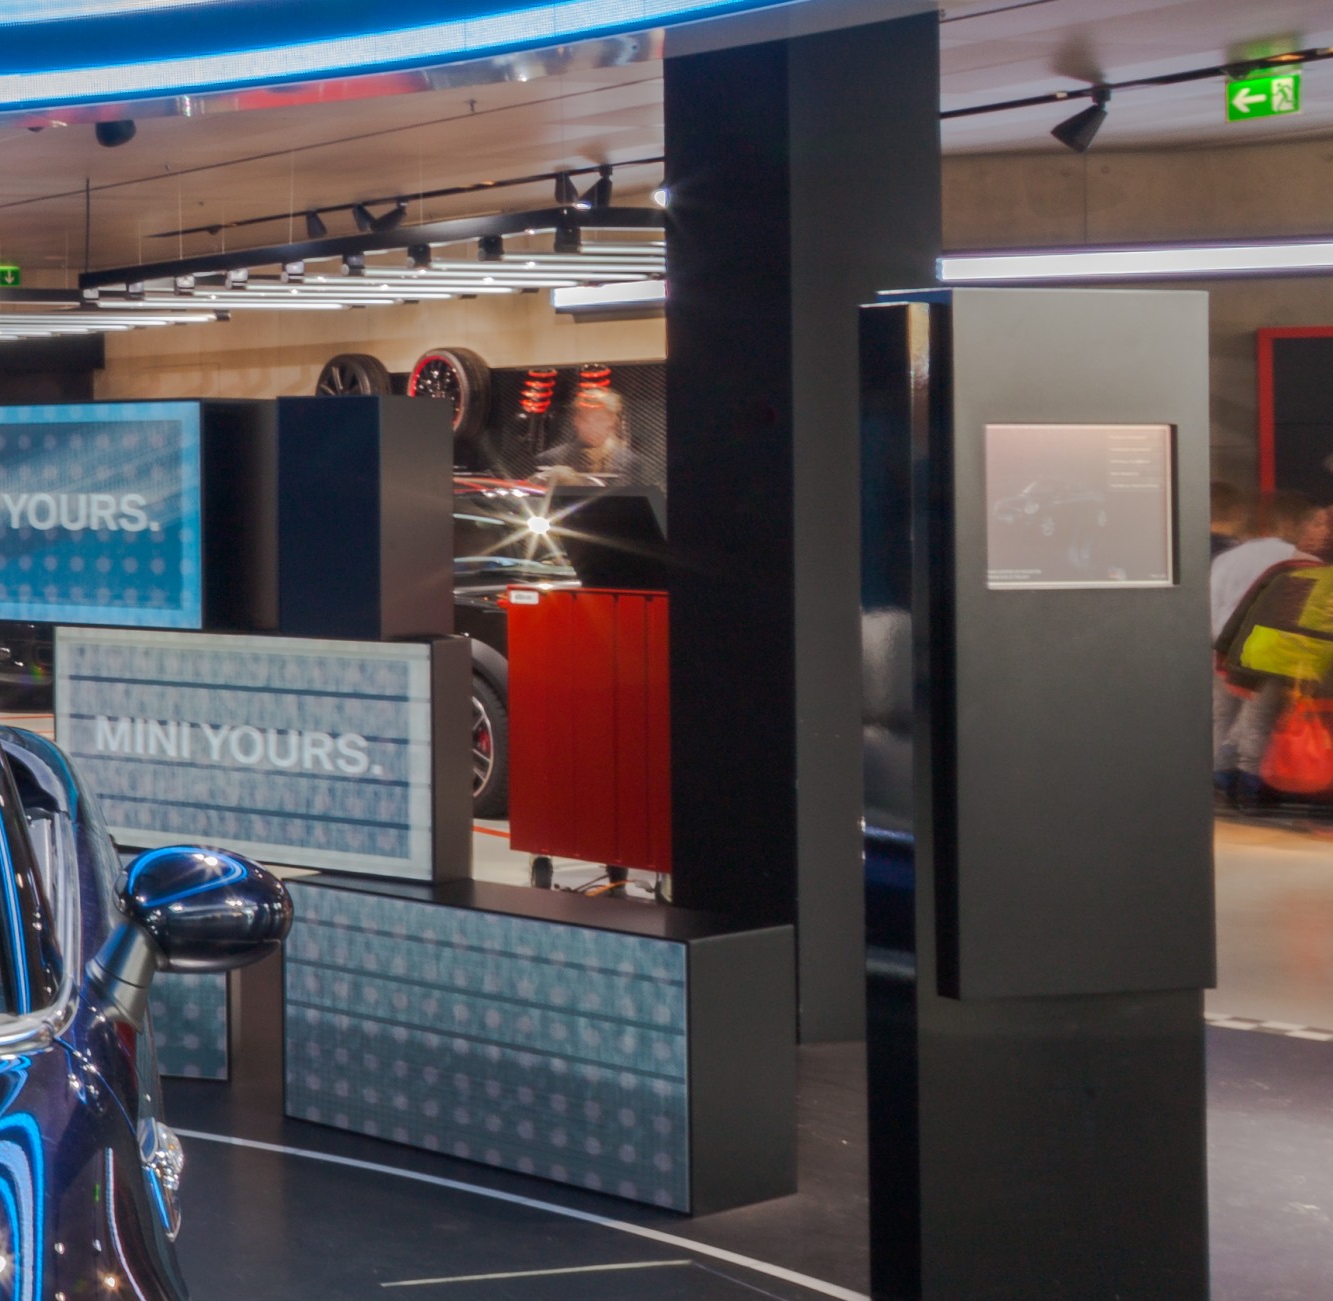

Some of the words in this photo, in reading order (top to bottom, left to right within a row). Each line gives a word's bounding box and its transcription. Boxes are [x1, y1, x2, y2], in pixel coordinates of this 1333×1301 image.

[2, 492, 161, 532] YOURS.
[94, 716, 191, 759] MINI
[202, 723, 384, 776] YOURS.
